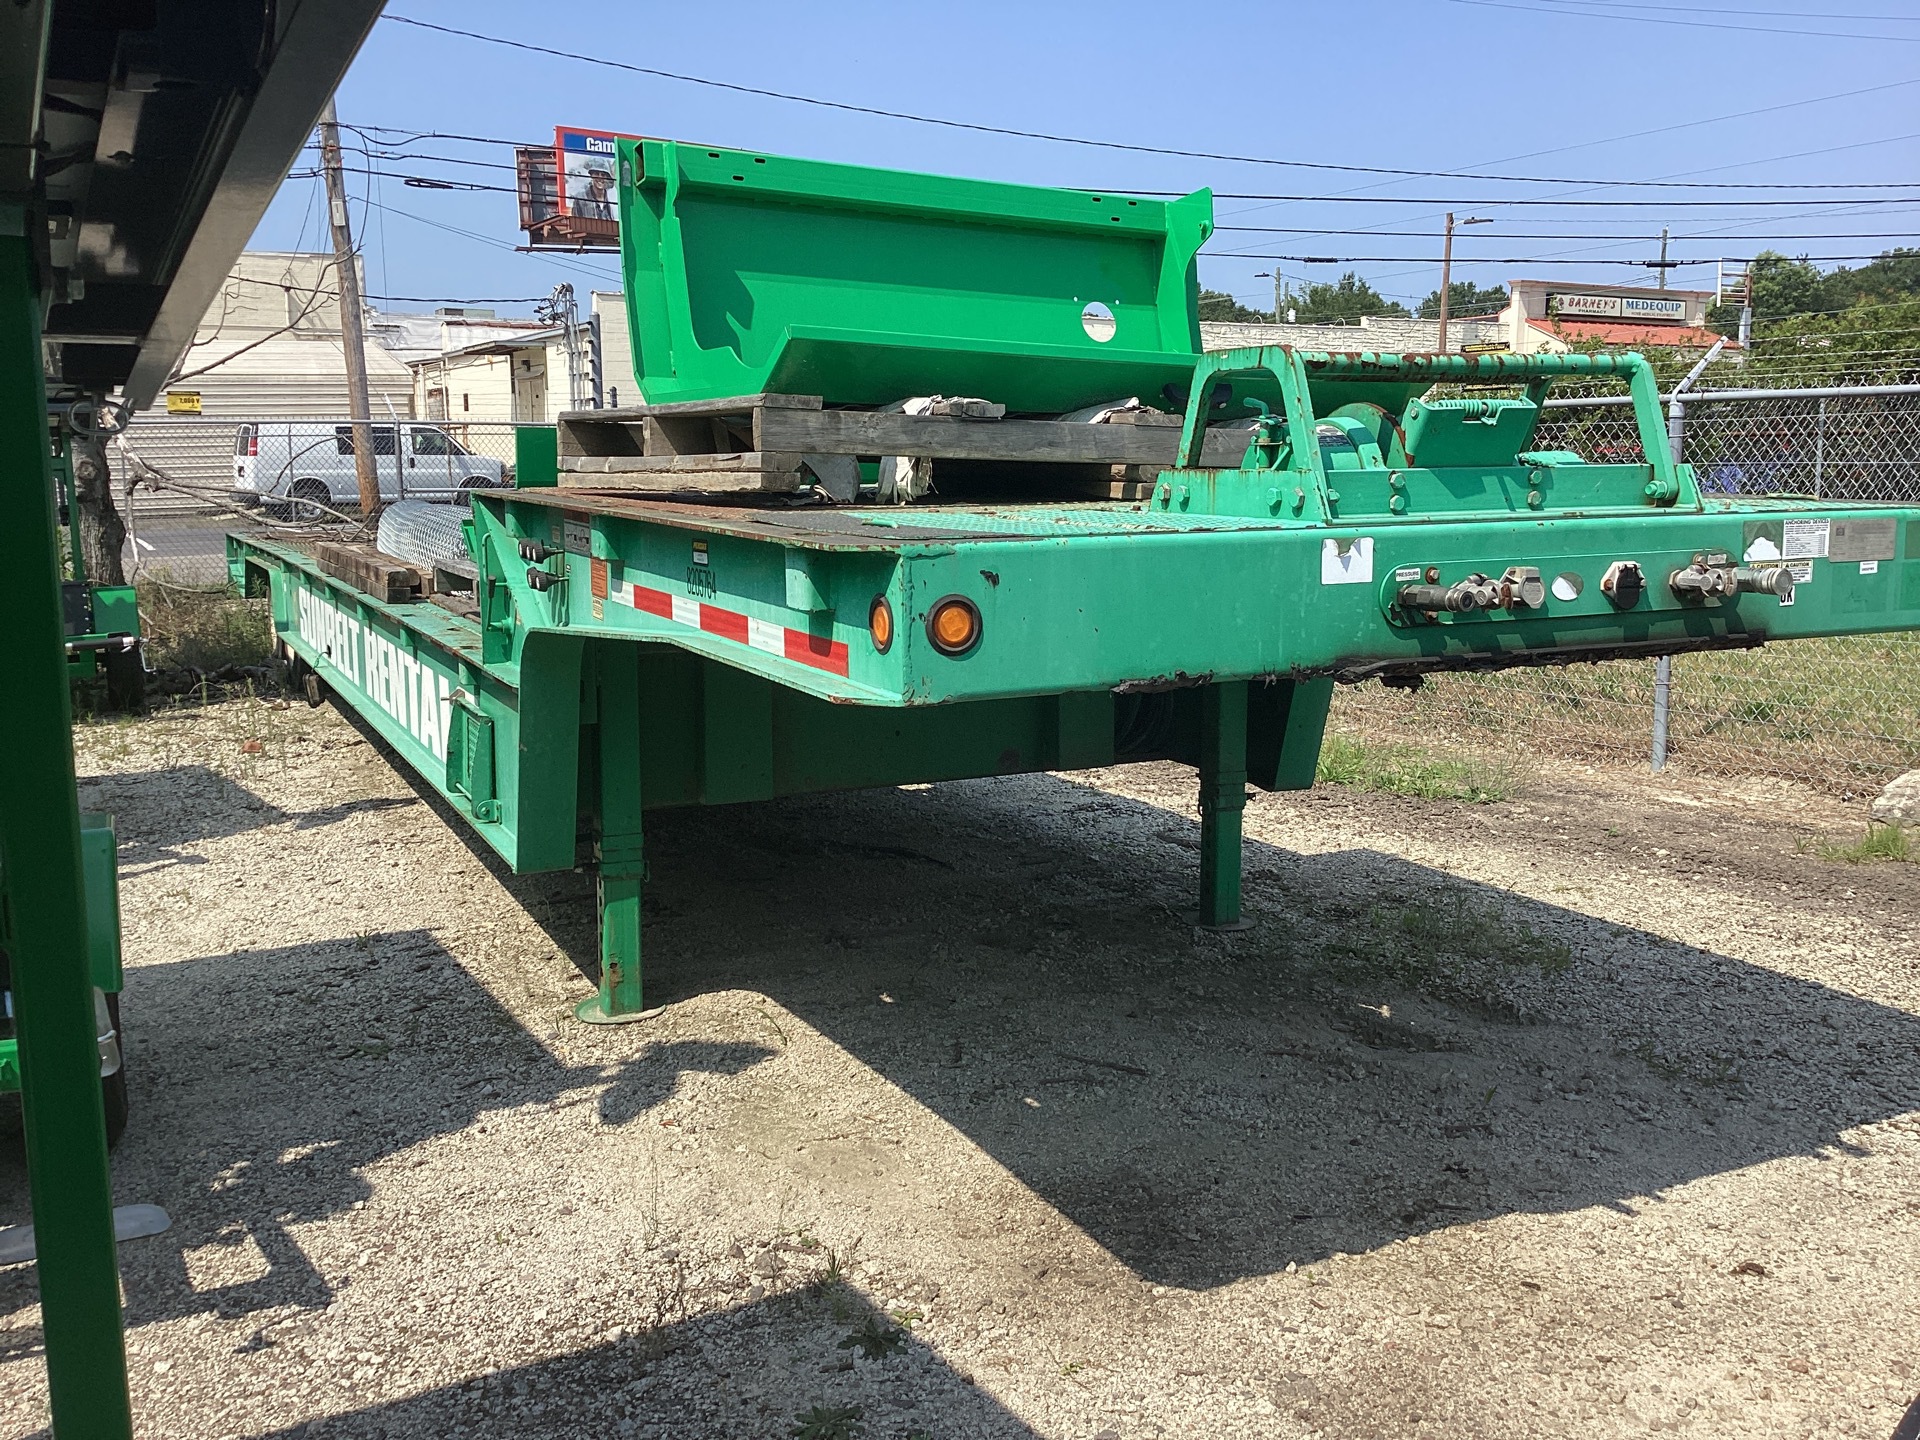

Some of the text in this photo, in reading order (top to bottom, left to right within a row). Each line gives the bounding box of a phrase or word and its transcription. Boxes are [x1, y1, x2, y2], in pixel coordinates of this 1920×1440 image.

[586, 137, 615, 153] Cam
[1568, 297, 1617, 310] BARNEY'S
[1625, 300, 1681, 312] MEDEQUIP
[299, 586, 475, 764] SUNBELT RENTAL
